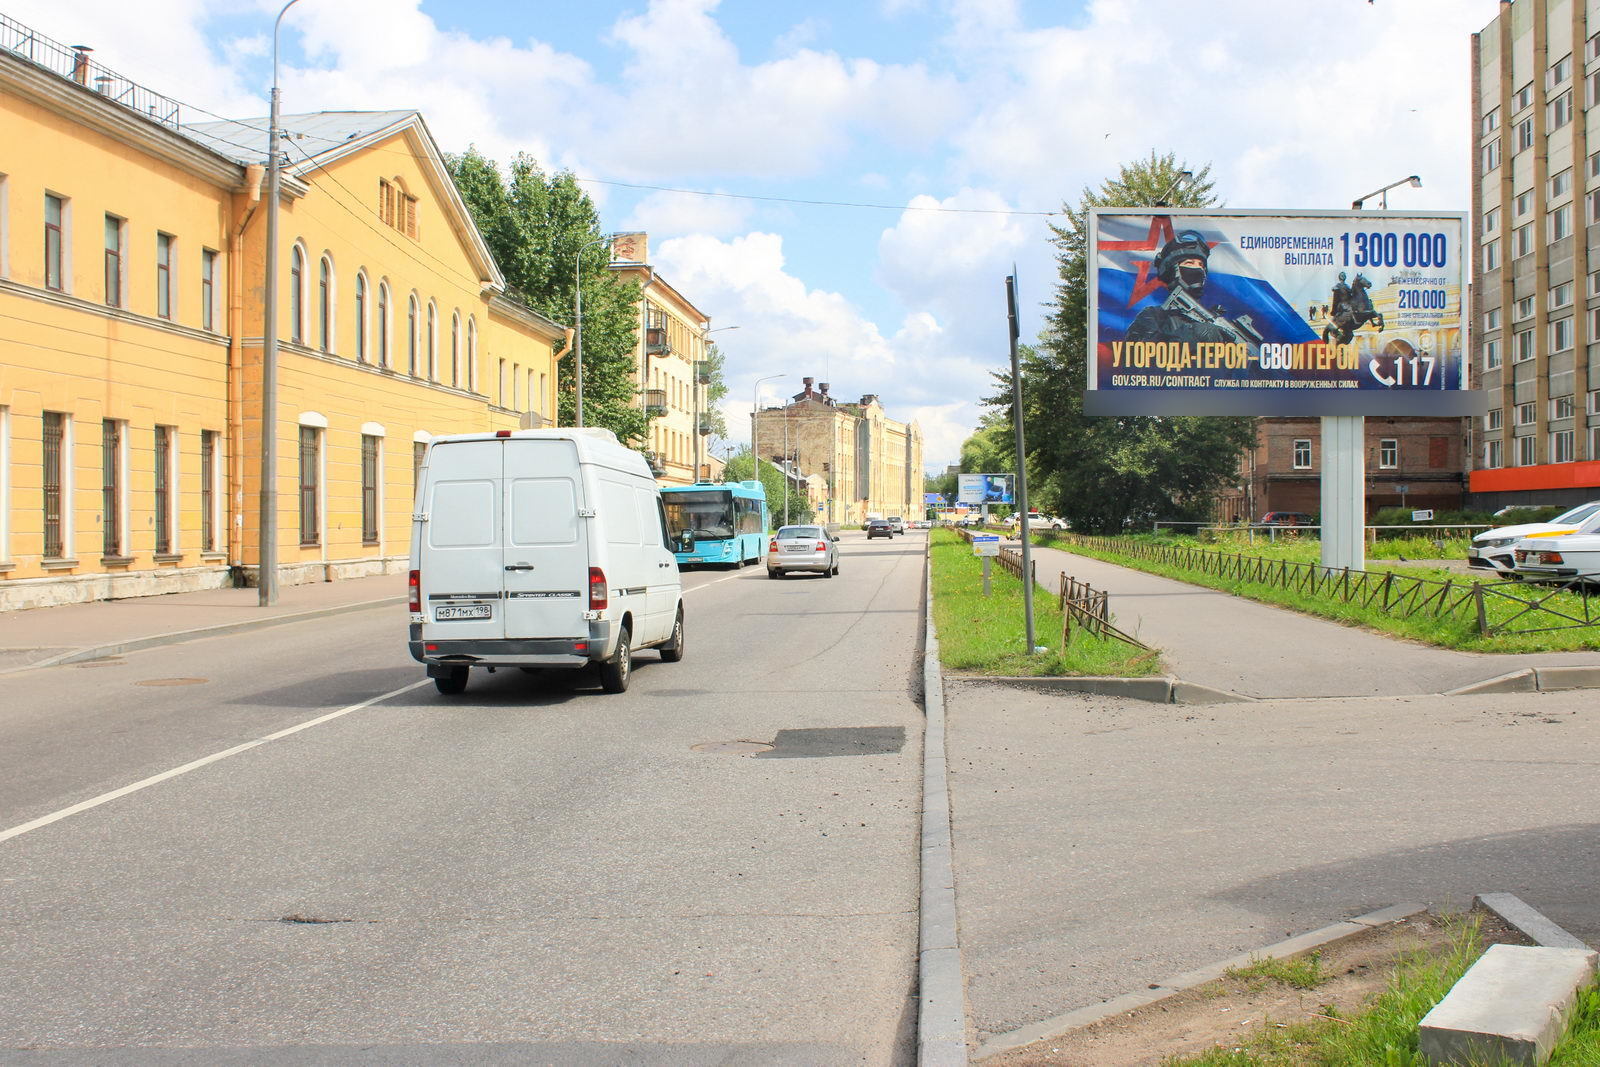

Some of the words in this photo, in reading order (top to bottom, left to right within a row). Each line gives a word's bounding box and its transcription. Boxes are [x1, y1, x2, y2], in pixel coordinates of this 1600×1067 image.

[1240, 236, 1334, 250] ЕДИНОВРЕМЕННАЯ
[1284, 253, 1334, 266] ВЫПЛАТА
[1112, 341, 1123, 368] У
[1307, 343, 1360, 370] ГЕРОИ
[1393, 356, 1436, 386] 117
[1112, 374, 1211, 387] GOV.SPB.RU/CONTRACT
[1214, 379, 1240, 388] СЛУЖБА
[1240, 379, 1249, 388] ПО
[1250, 379, 1284, 388] КОНТРАКТУ
[1290, 380, 1337, 389] ВООРУЖЕННЫХ
[1338, 380, 1359, 389] СИЛАХ
